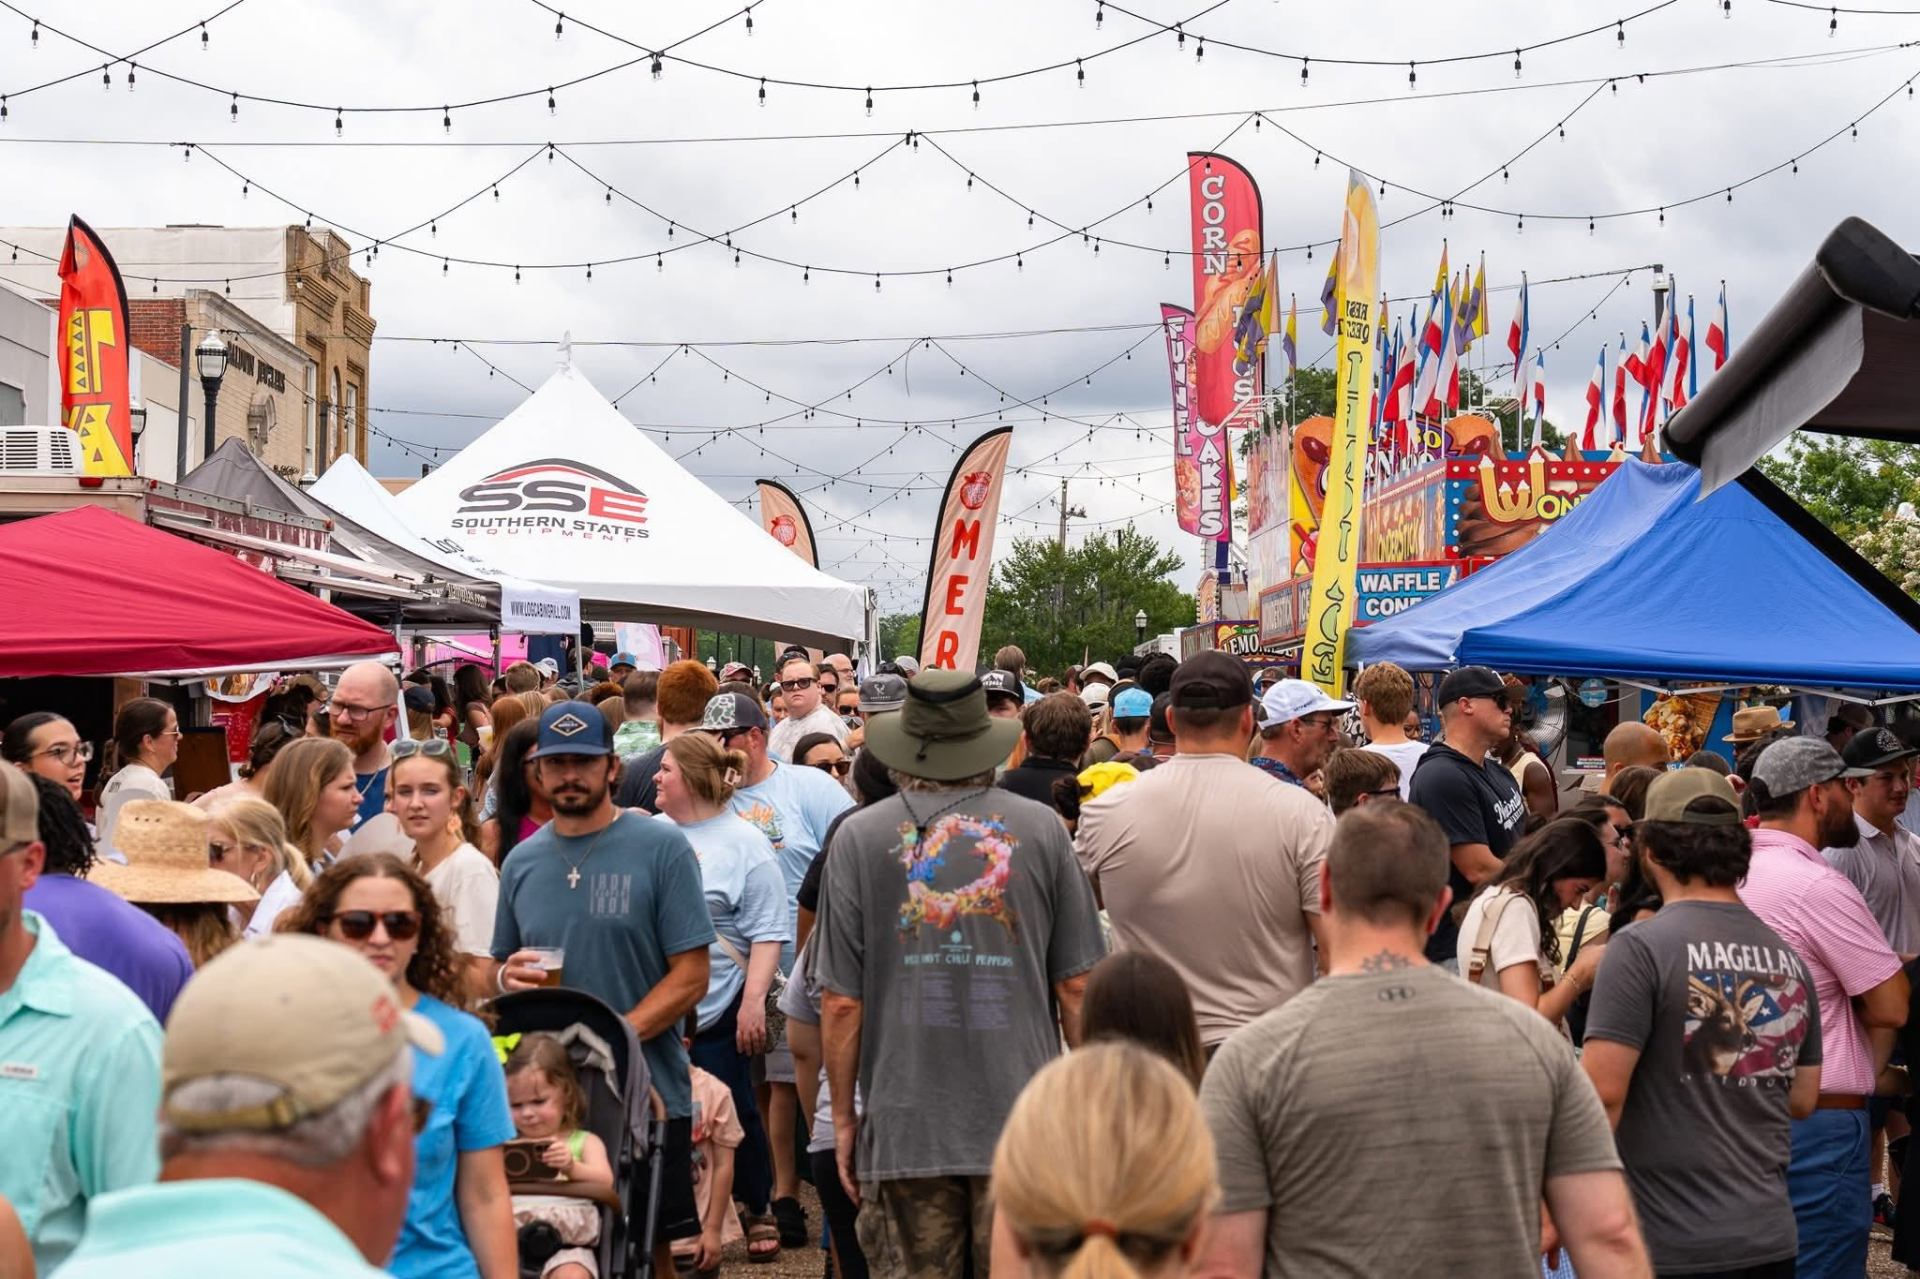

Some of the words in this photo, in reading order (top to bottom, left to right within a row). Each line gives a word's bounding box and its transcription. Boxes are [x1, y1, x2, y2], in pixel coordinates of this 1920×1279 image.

[1201, 174, 1228, 276] CORN
[1167, 315, 1193, 456] FUNNEL
[457, 480, 650, 524] SSE
[451, 516, 566, 529] SOUTHERN
[572, 520, 650, 539] STATES
[466, 528, 632, 543] EQUIPMENT
[935, 519, 981, 670] MER
[1360, 572, 1441, 593] WAFFLE
[1365, 597, 1423, 617] CON
[1687, 940, 1805, 981] MAGELLAN
